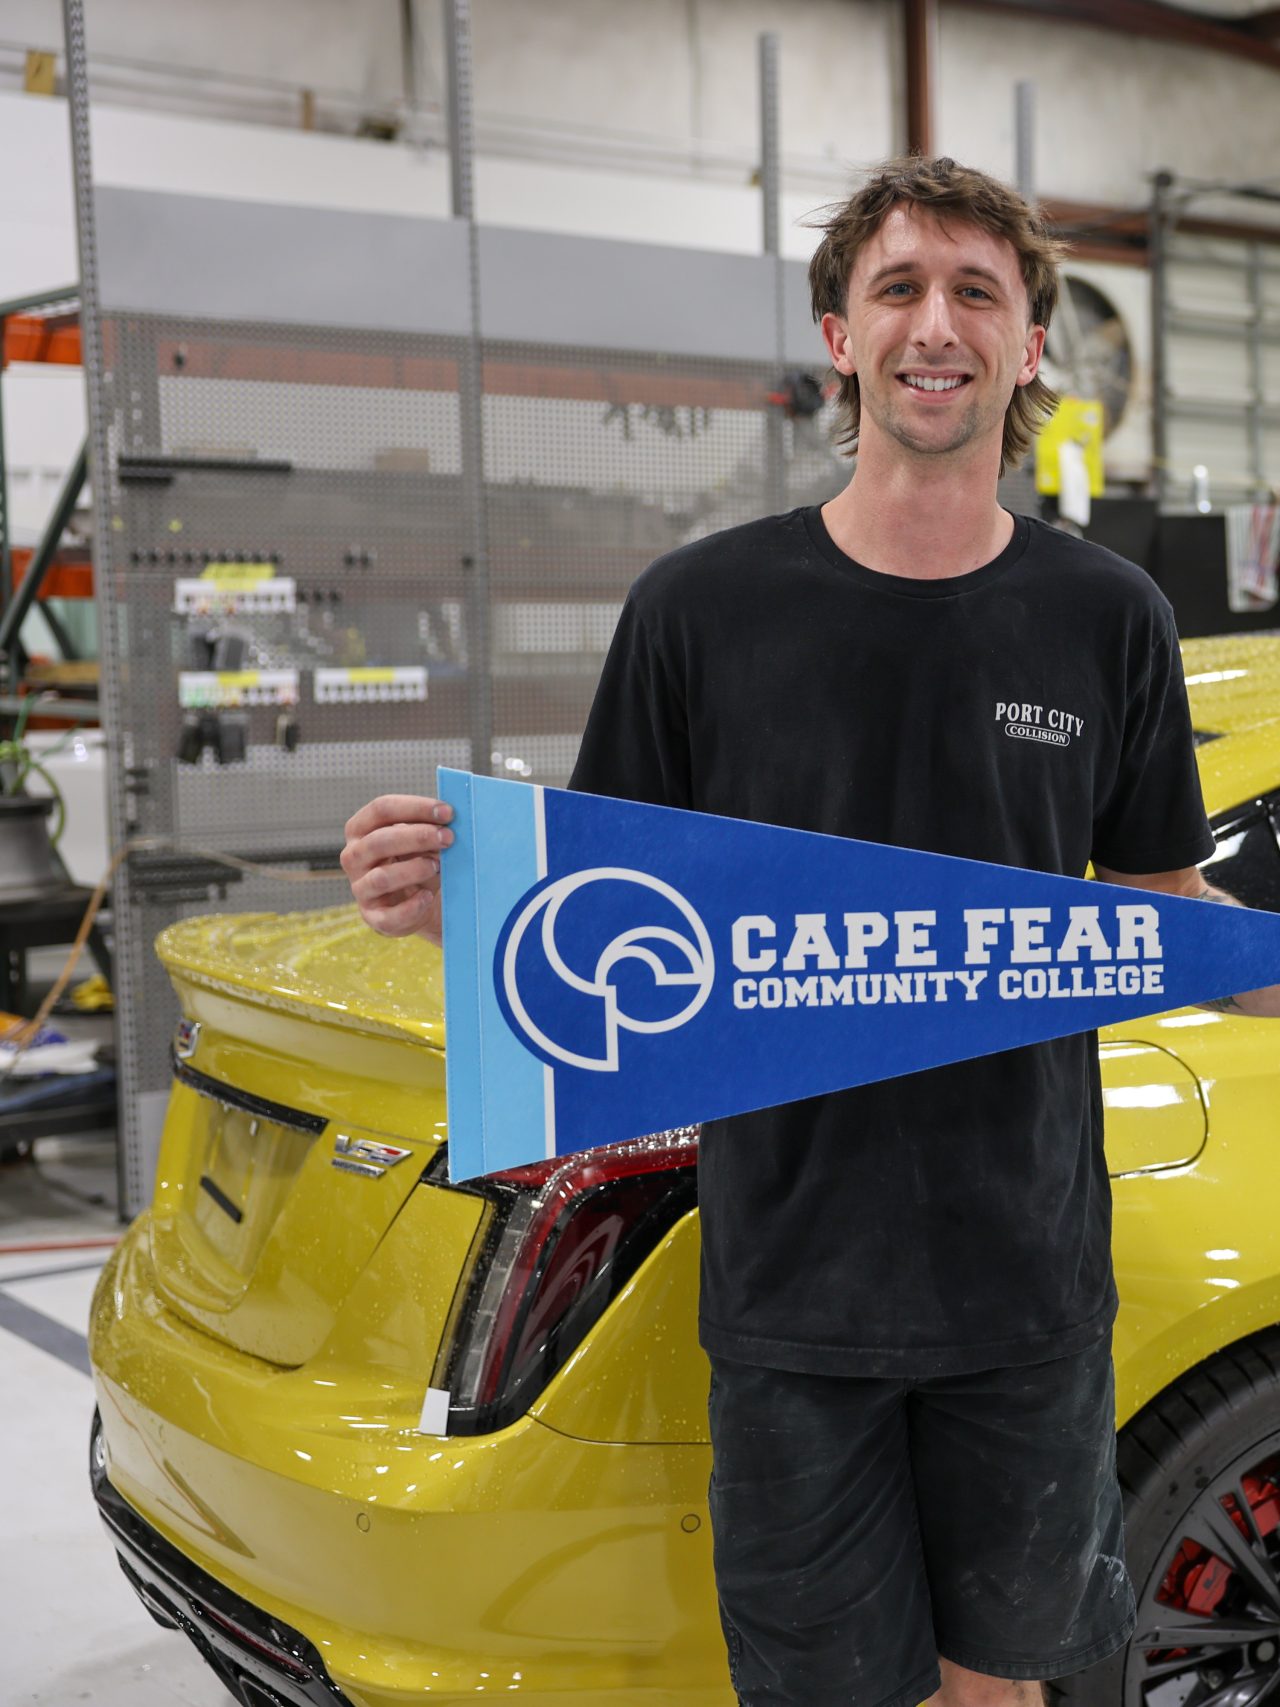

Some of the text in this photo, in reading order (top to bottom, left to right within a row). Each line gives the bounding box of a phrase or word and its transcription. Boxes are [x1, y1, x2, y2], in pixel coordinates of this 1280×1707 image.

[995, 702, 1084, 737] PORT CITY
[1009, 725, 1066, 744] COLLISION
[731, 904, 1163, 973] CAPE FEAR
[733, 964, 1164, 1010] COMMUNITY COLLEGE
